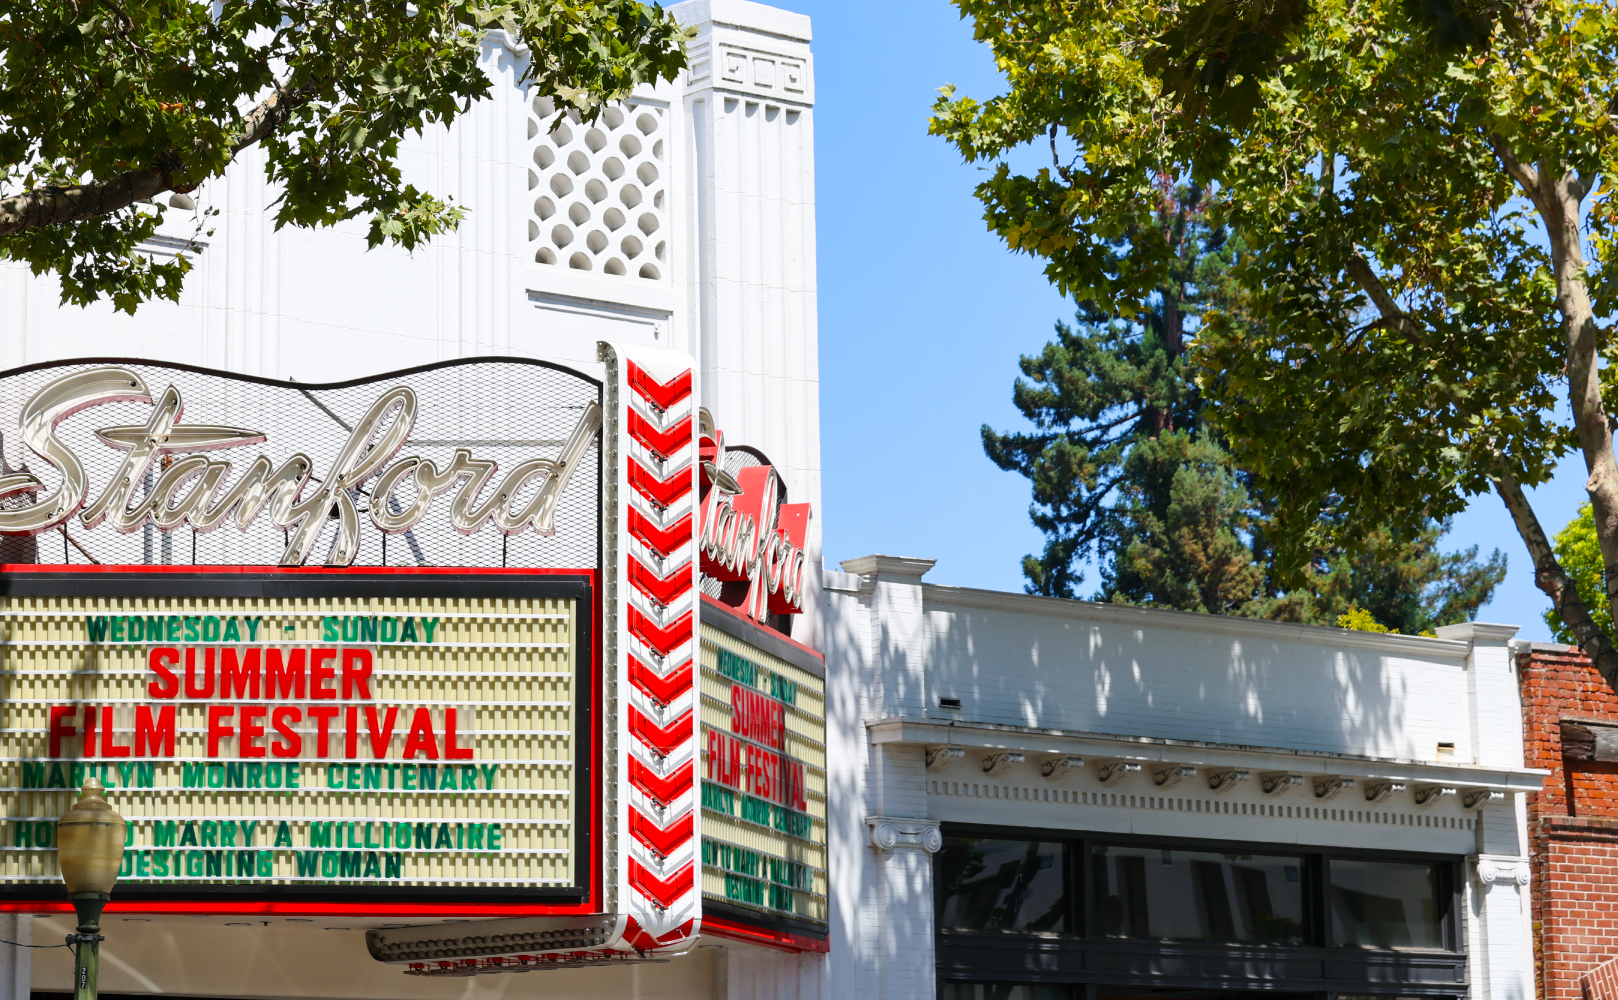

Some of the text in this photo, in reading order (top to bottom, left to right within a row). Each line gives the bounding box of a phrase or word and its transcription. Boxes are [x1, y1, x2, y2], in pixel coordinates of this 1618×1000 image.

[0, 366, 602, 567] Stanford
[700, 406, 812, 623] tanford
[85, 616, 262, 642] WEDNESDAY
[323, 616, 439, 643] SUNDAY
[148, 647, 372, 699] SUMMER
[50, 706, 474, 759] FILM FESTIVAL
[732, 685, 784, 752] SUMMER
[23, 762, 498, 790] MARILYN MONROE CENTENARY
[709, 729, 807, 811] FILM FESTIVAL
[15, 821, 58, 848] HO
[154, 821, 257, 848] MARRY
[274, 821, 293, 848] A
[310, 821, 501, 850] MILLIONAIRE
[118, 850, 401, 878] DESIGNING WOMAN
